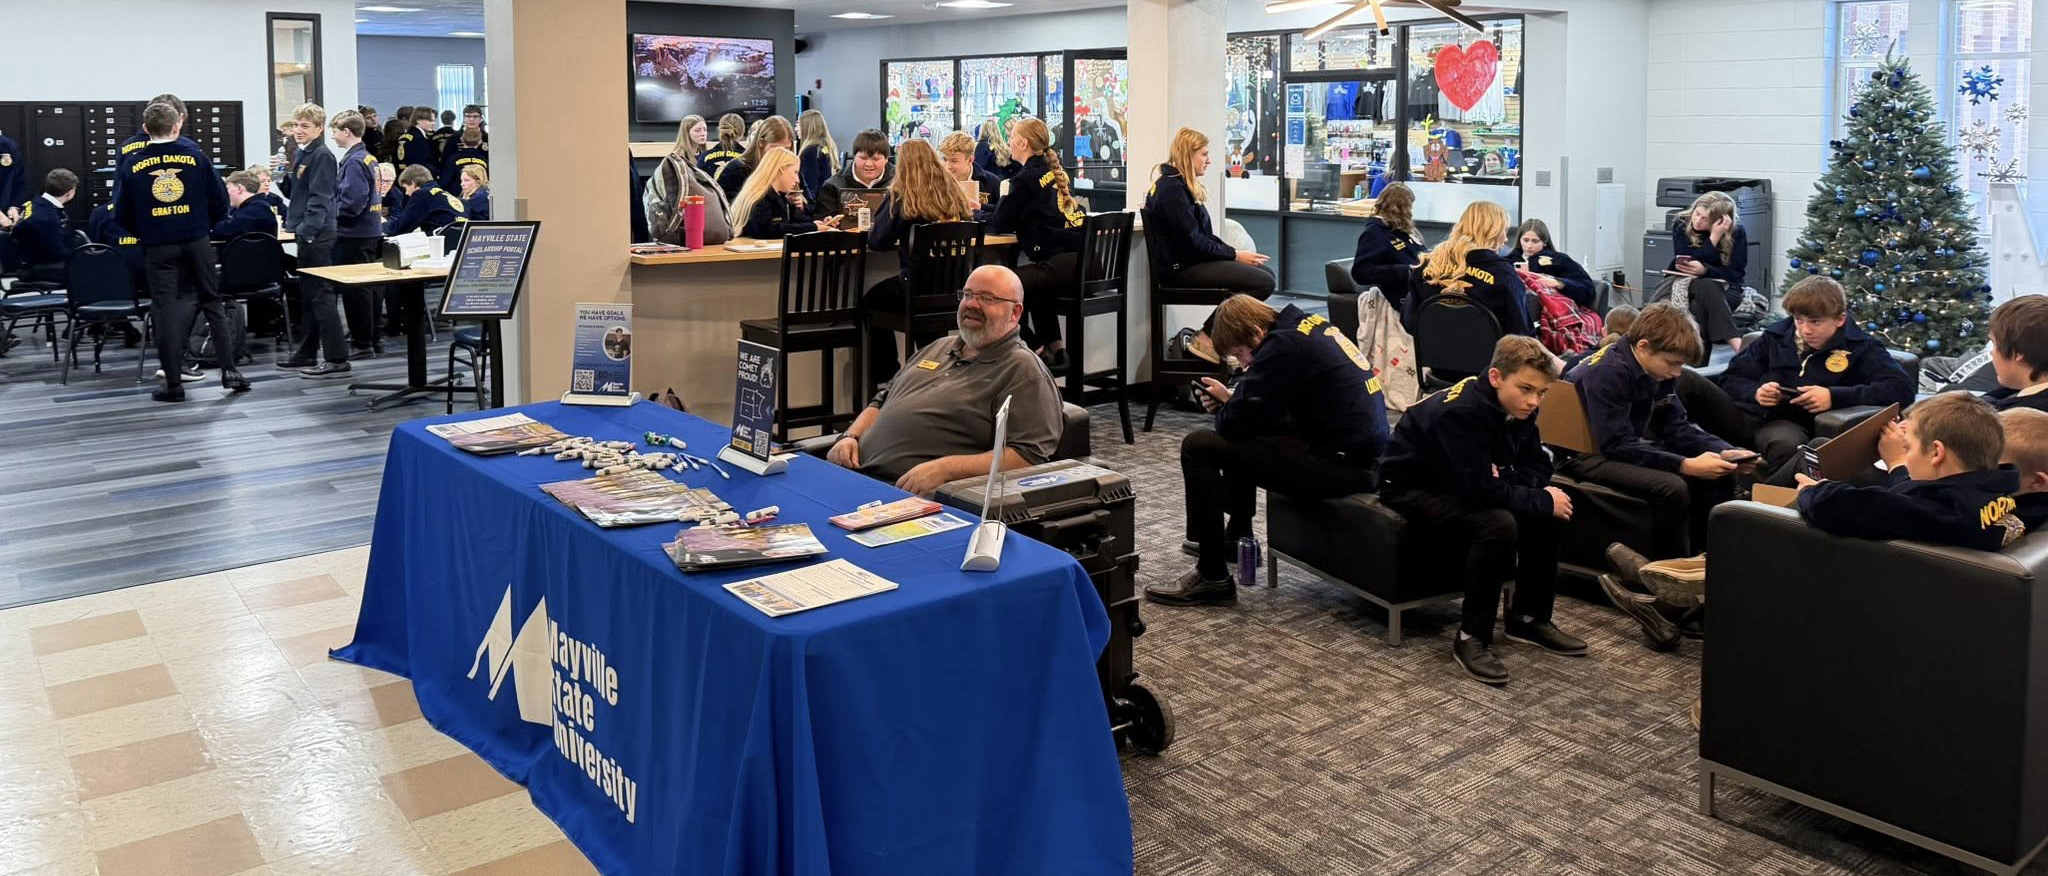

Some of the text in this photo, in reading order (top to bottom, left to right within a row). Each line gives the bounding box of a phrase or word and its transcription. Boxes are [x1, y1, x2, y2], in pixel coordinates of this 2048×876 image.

[132, 155, 197, 173] NORTH DAKOTA
[1039, 171, 1055, 188] NOR
[152, 204, 190, 217] GRAFTON
[467, 246, 523, 254] SCHOLARSHIP PORTAL
[1465, 266, 1495, 285] AKOTA
[740, 352, 761, 365] WE ARE
[739, 361, 758, 372] COMET
